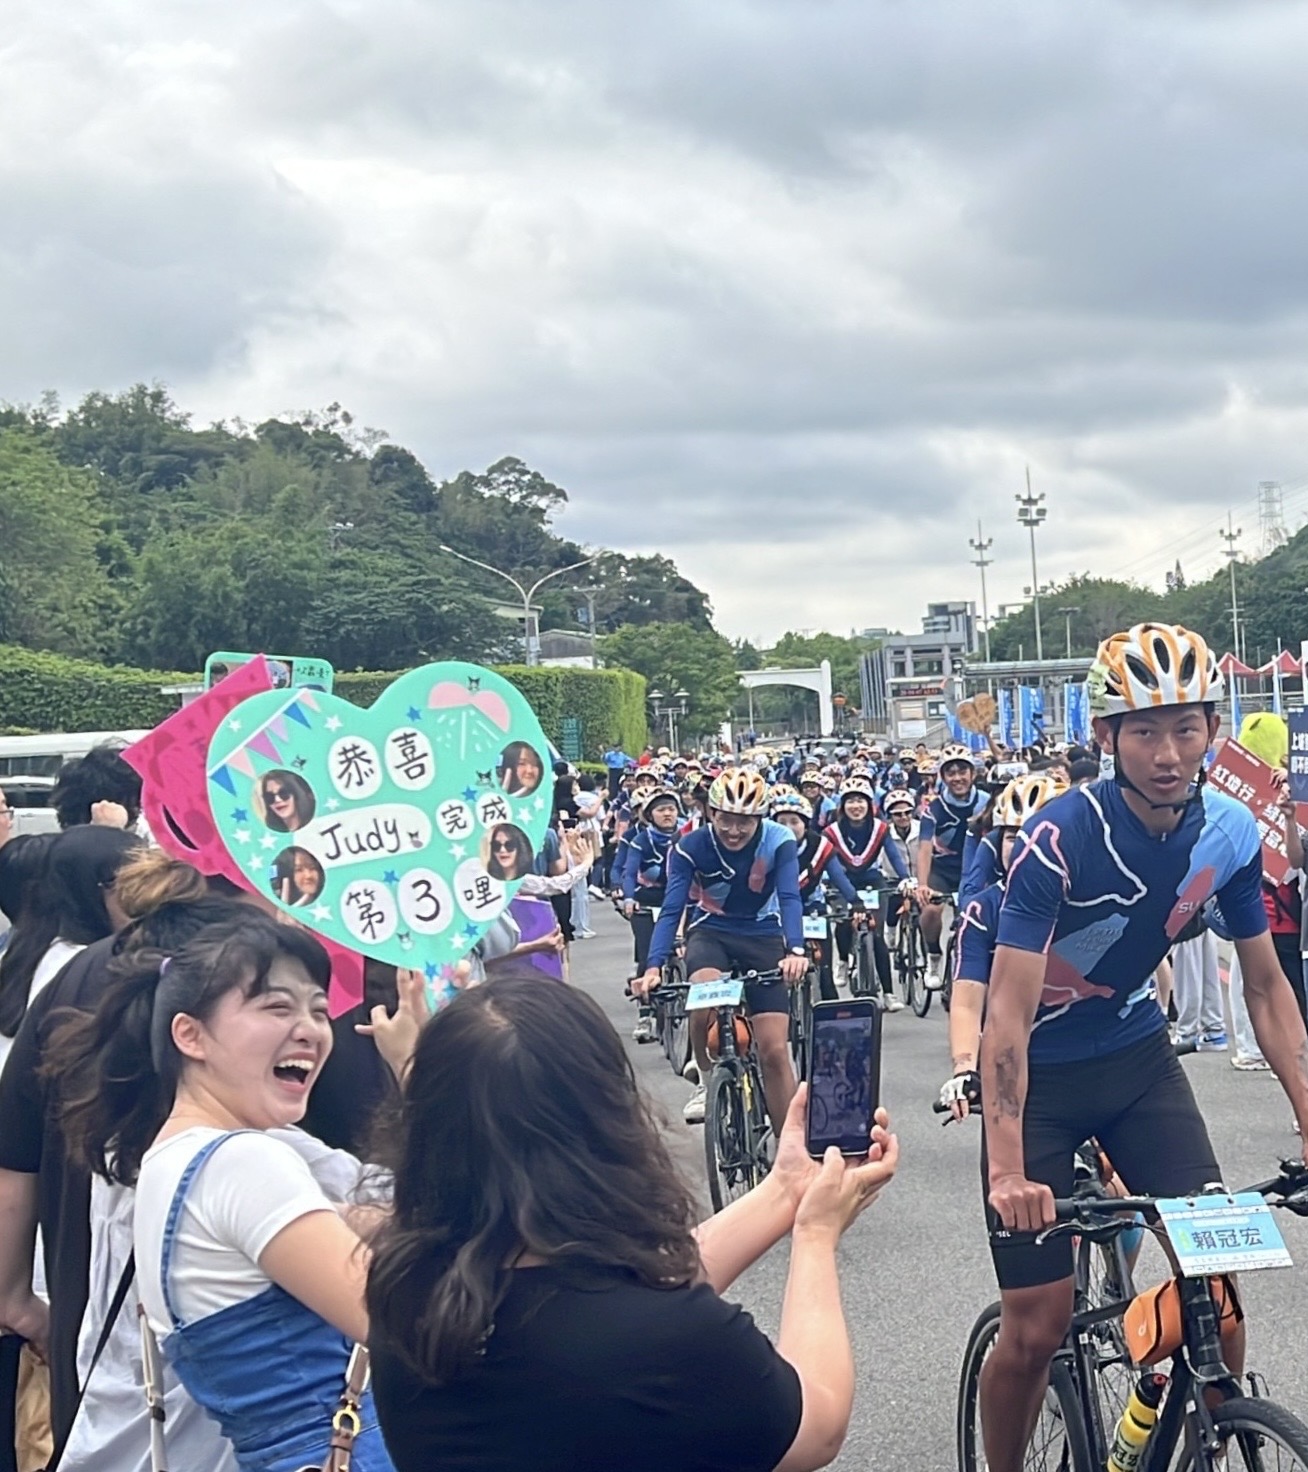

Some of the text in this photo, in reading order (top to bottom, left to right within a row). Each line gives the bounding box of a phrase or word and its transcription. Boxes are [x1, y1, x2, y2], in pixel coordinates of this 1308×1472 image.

[337, 732, 428, 788] 恭喜
[441, 796, 508, 834] 完成
[320, 817, 401, 860] Judy
[345, 875, 502, 940] 第3哩
[1191, 1227, 1264, 1251] 賴冠宏
